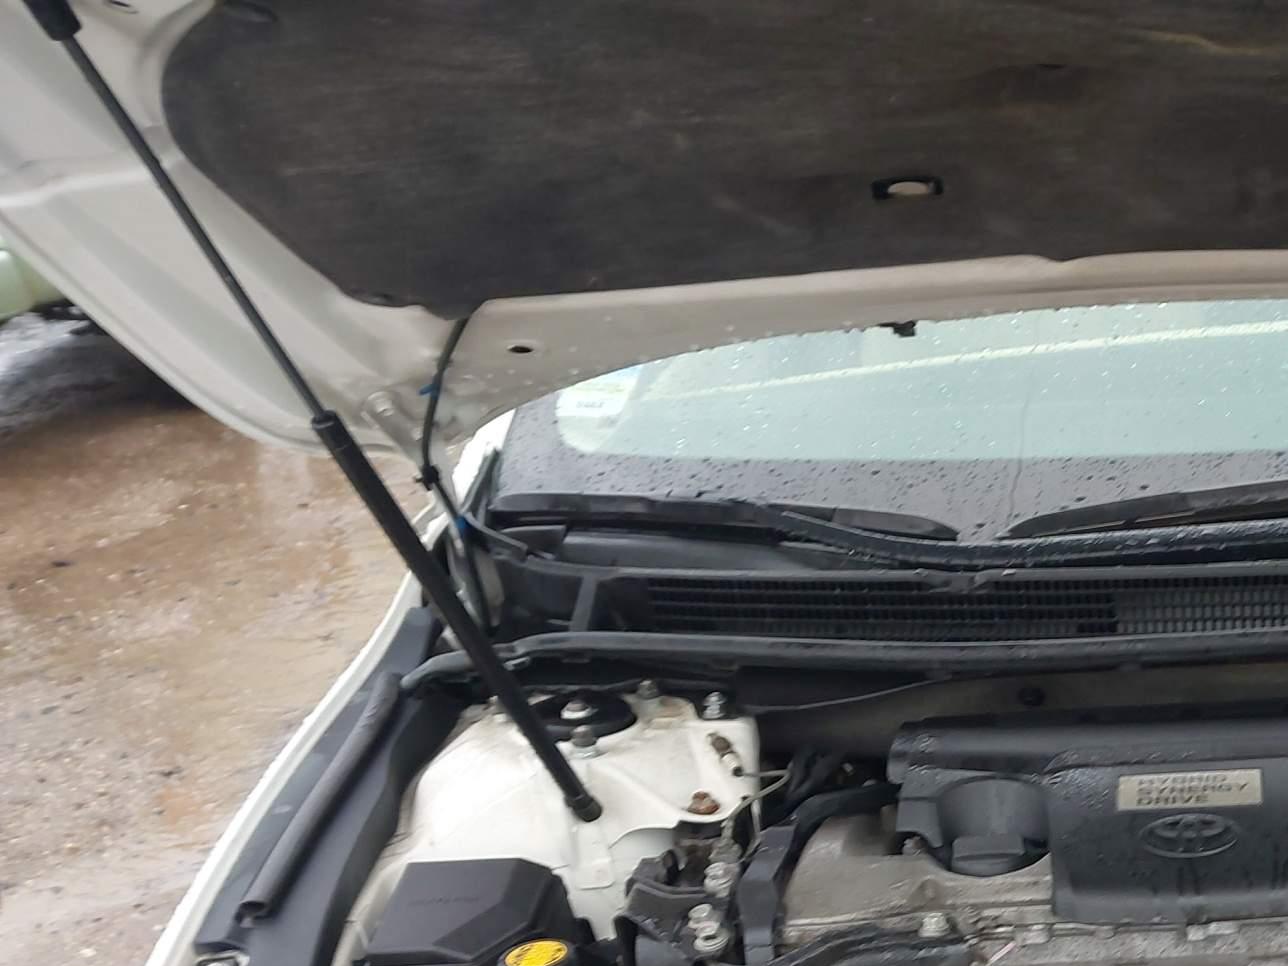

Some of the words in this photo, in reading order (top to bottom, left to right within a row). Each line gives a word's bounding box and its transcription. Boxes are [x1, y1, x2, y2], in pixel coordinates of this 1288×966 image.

[1137, 774, 1227, 786] HYBRID
[1137, 783, 1248, 796] SYNERGY
[1136, 794, 1209, 806] DRIVE
